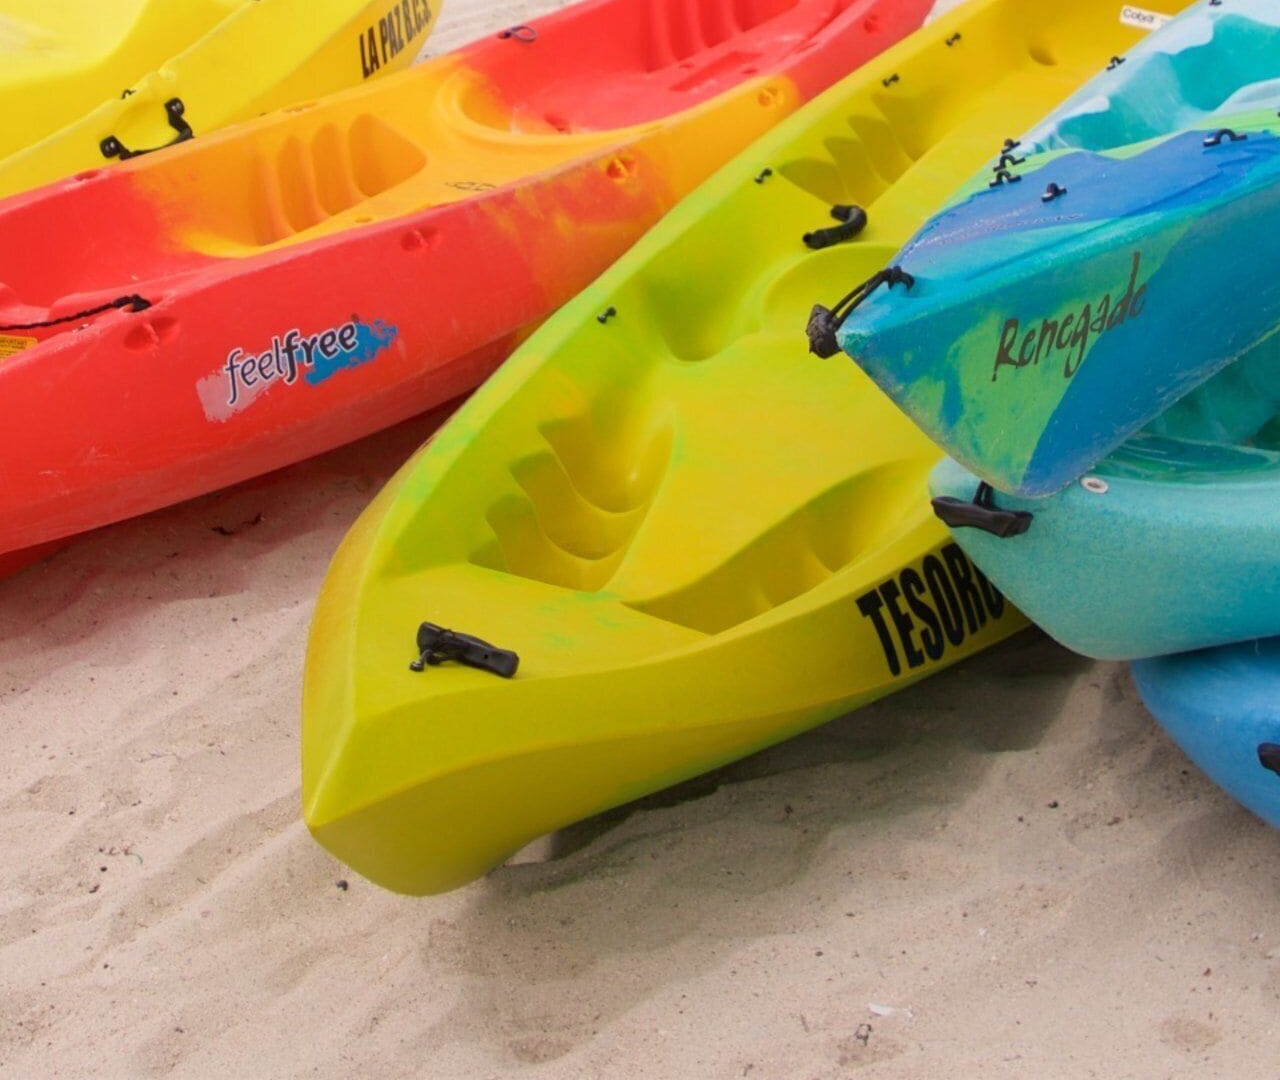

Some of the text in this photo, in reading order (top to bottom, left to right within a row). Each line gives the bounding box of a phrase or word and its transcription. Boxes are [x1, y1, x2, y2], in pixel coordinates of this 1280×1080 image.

[359, 26, 380, 79] LA
[378, 4, 405, 65] PAZ
[991, 250, 1148, 383] Renegade
[225, 322, 357, 405] feelfree
